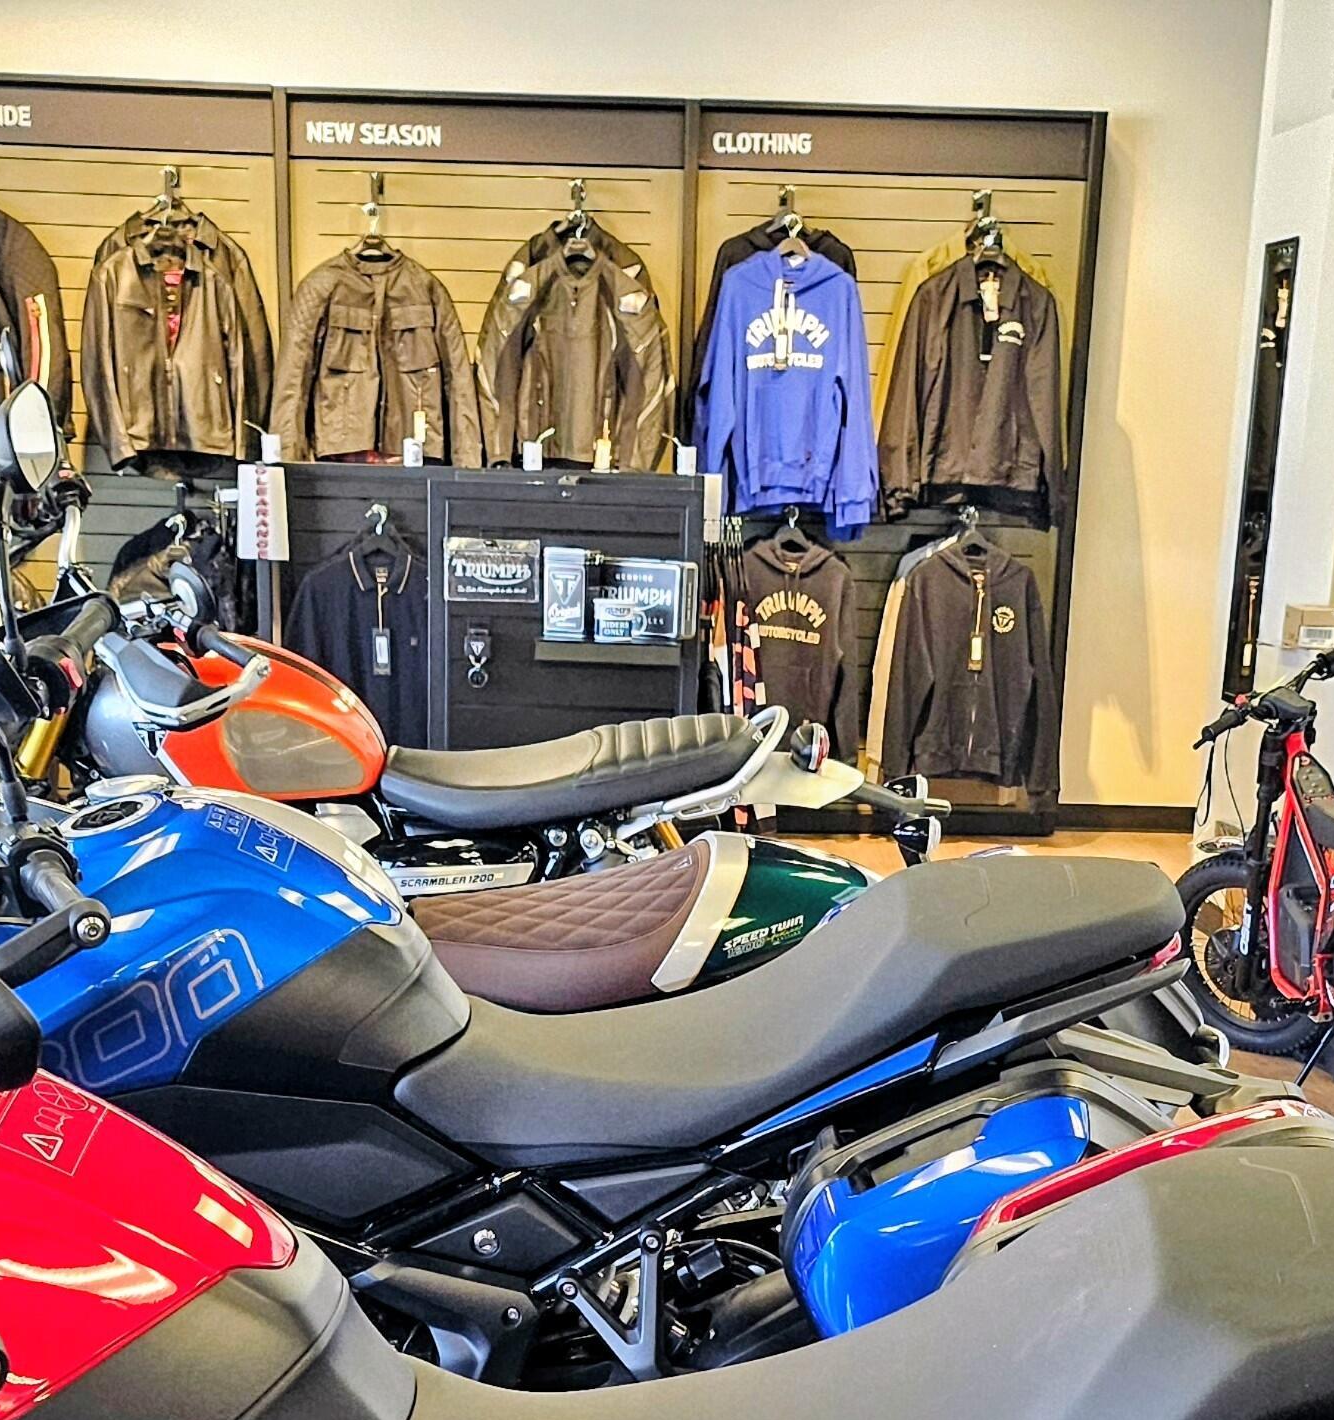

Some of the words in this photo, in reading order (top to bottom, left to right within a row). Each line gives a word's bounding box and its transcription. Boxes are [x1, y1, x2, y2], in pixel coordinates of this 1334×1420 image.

[306, 120, 355, 144] NEW
[359, 122, 442, 147] SEASON
[712, 131, 812, 154] CLOTHING
[451, 558, 532, 583] TRIUMPH
[755, 590, 827, 629] TRIUMPH
[400, 876, 466, 888] SCRAMBLER
[468, 873, 495, 883] 1200
[723, 927, 770, 951] SPEED
[770, 914, 804, 934] TWIN
